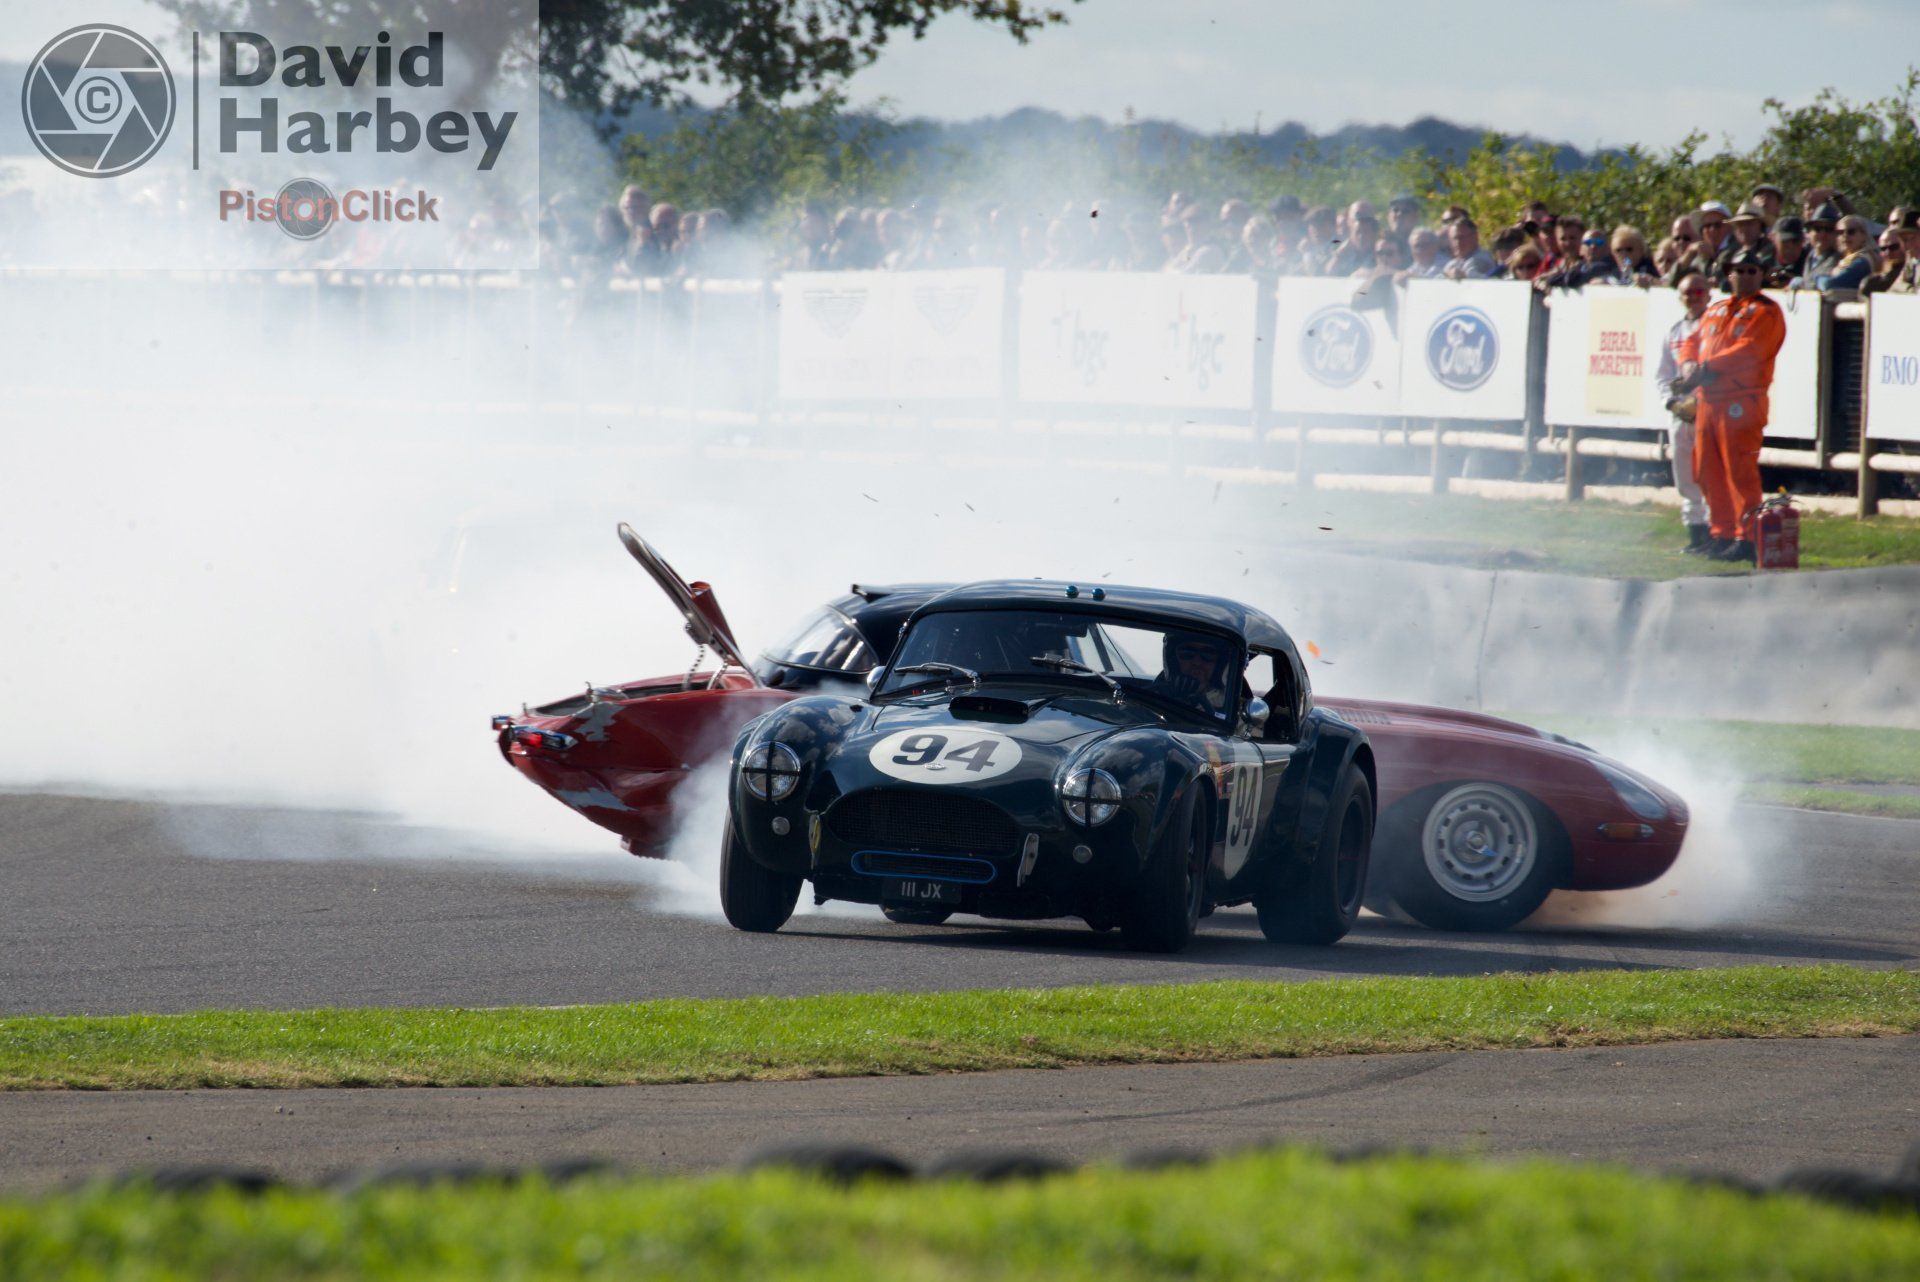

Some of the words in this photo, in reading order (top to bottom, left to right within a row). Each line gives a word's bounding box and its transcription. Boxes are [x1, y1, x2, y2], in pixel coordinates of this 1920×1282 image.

[1315, 317, 1361, 373] Ford
[1440, 318, 1486, 375] Ford
[1599, 331, 1636, 352] BIRRA
[1589, 354, 1643, 376] MORETTI
[1880, 355, 1919, 386] BMO
[892, 734, 1000, 773] 94
[1230, 765, 1259, 848] 94
[920, 883, 942, 899] JX
